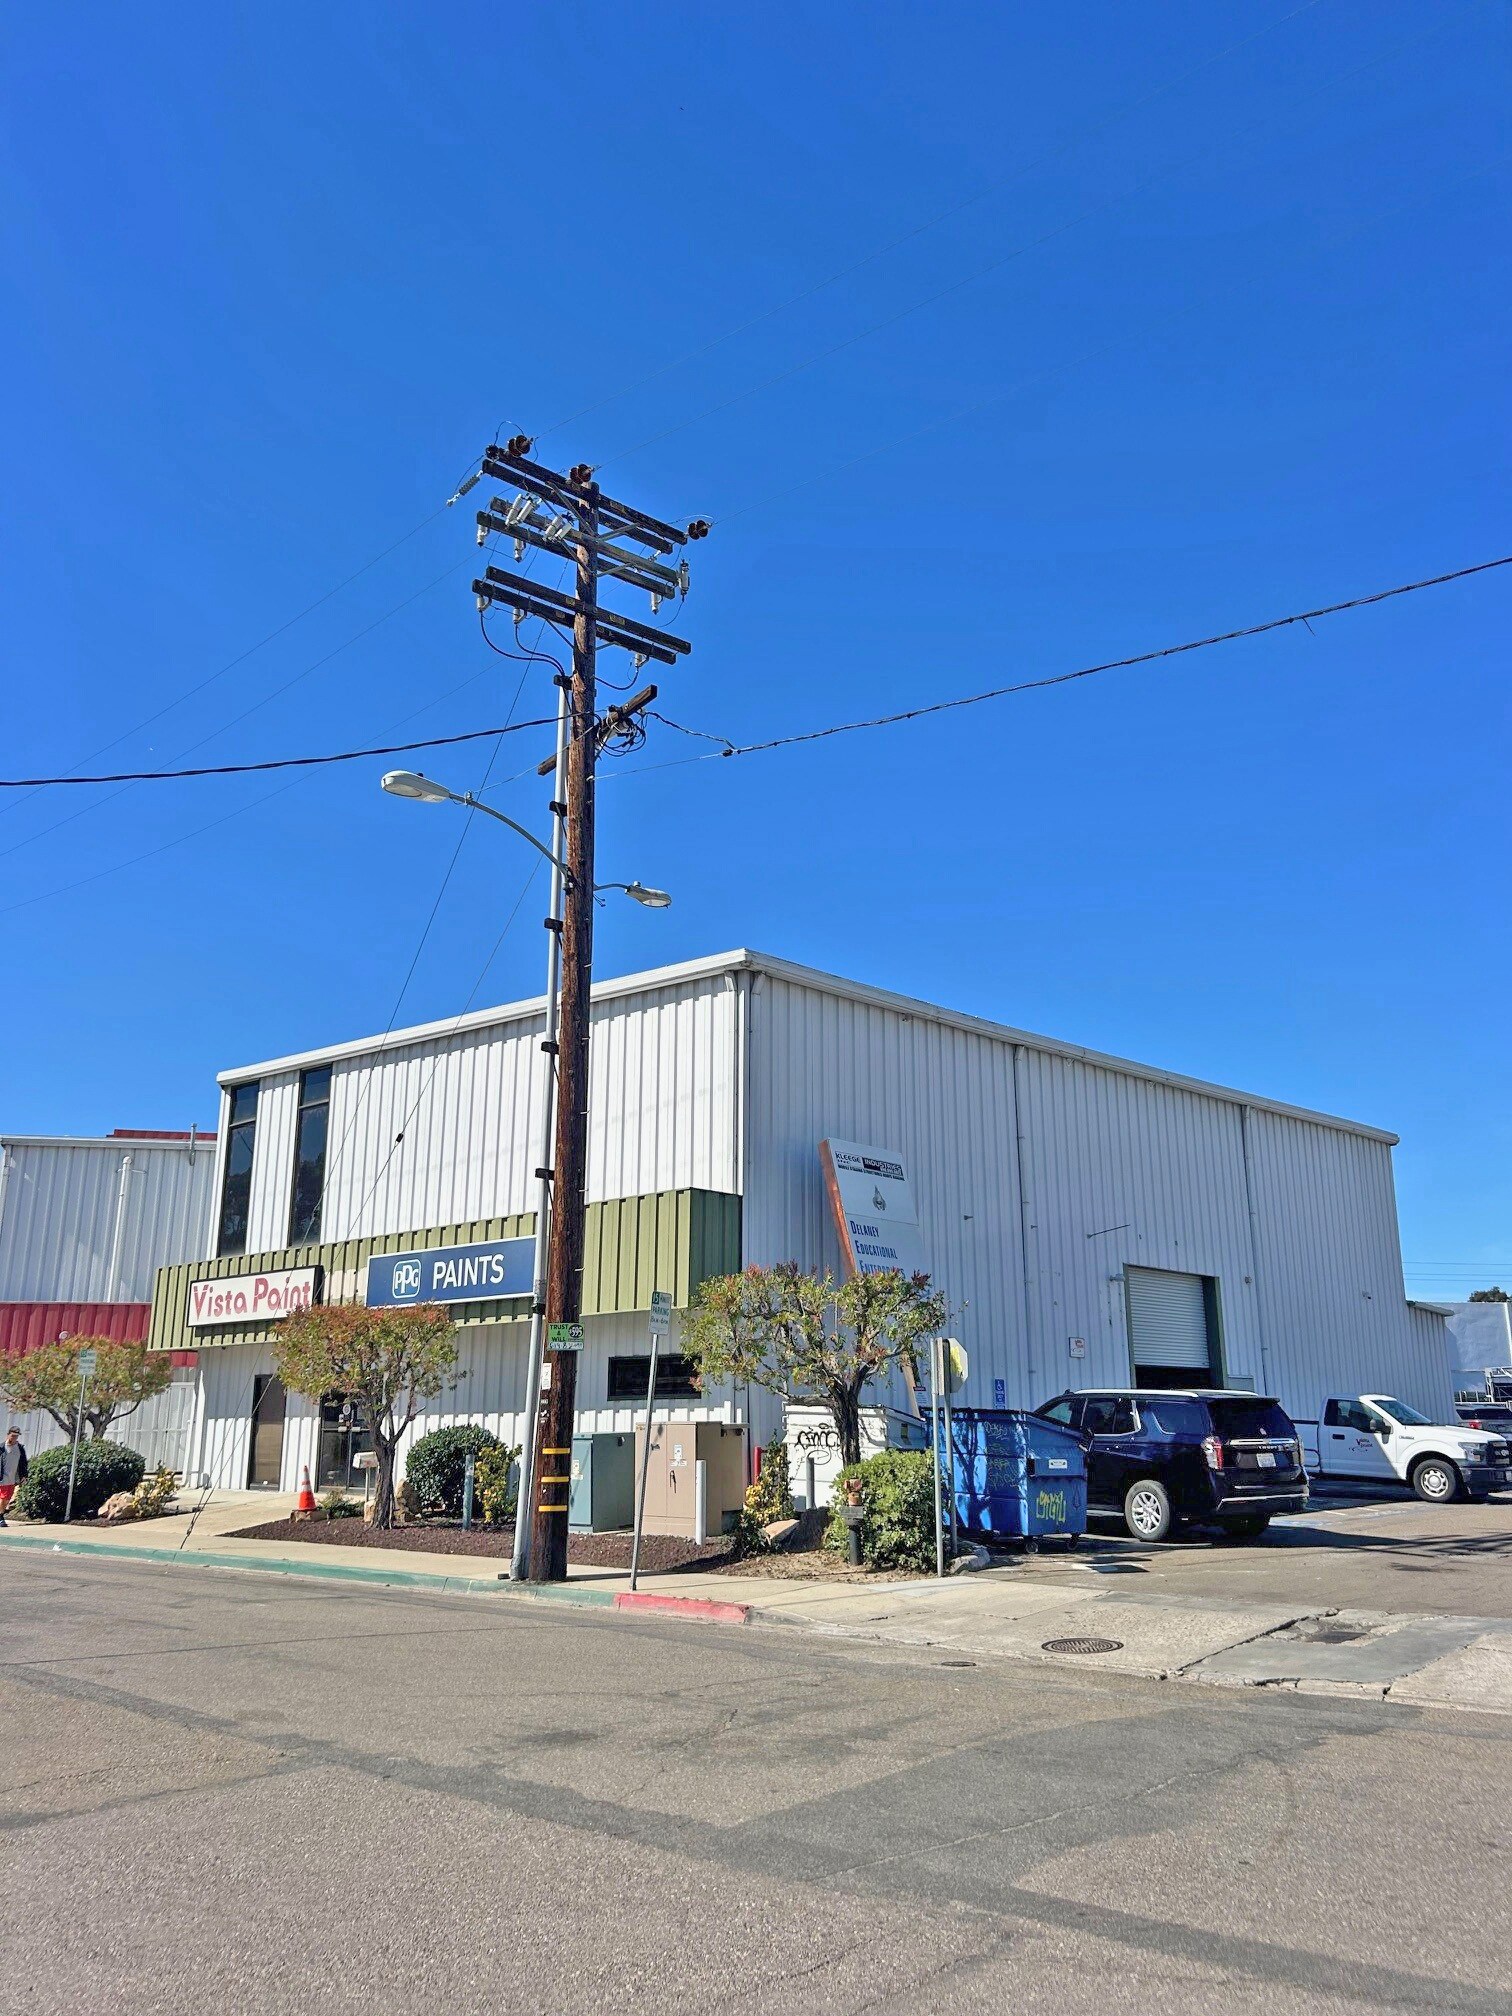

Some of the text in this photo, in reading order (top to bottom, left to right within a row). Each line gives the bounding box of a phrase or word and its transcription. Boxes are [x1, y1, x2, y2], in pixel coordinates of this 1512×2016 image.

[394, 1253, 505, 1294] PPG PAINTS
[193, 1277, 310, 1321] Vista Paint
